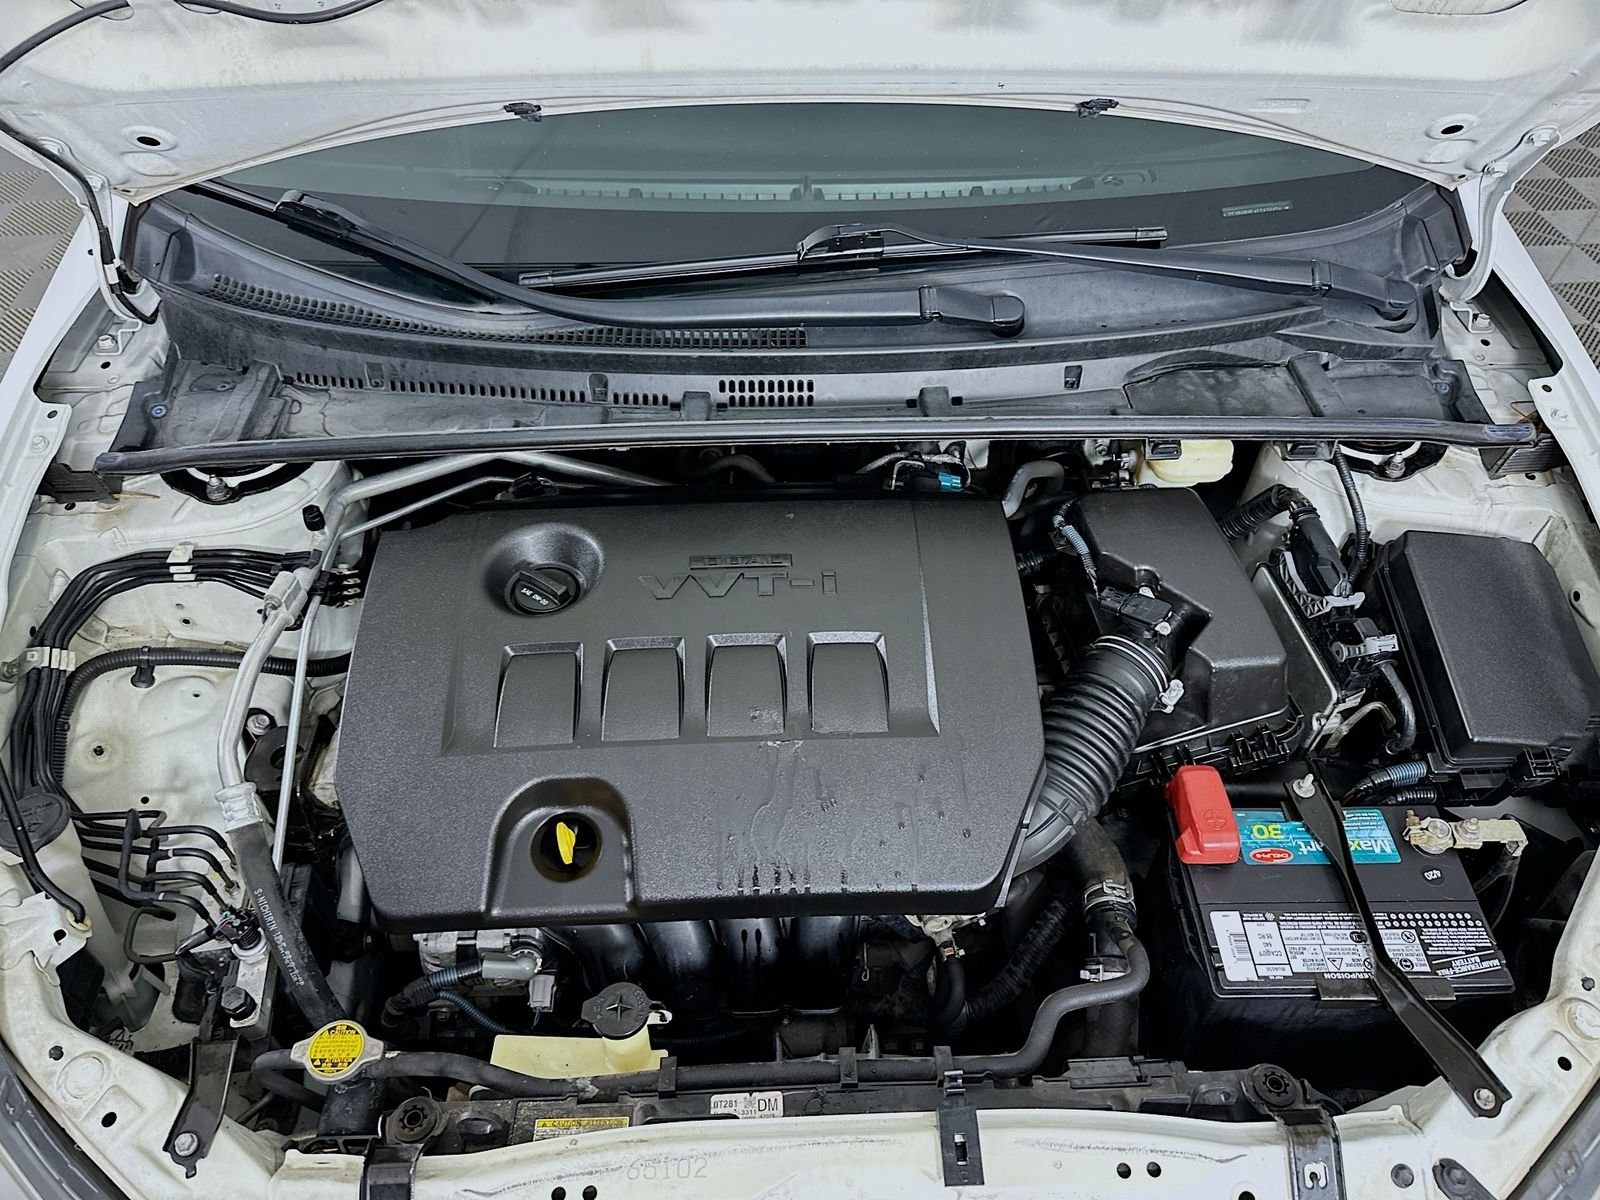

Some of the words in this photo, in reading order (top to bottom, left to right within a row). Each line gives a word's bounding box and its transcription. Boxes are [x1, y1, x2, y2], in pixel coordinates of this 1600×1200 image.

[638, 570, 838, 600] VVT-i
[1252, 824, 1285, 840] 30
[1255, 852, 1290, 860] DELPHI
[1435, 958, 1501, 976] MAINTENANCE-FREE
[1452, 956, 1480, 967] BATTERY
[1323, 972, 1372, 980] ER/POISON
[757, 1098, 779, 1112] DM
[626, 1157, 708, 1181] 65102
